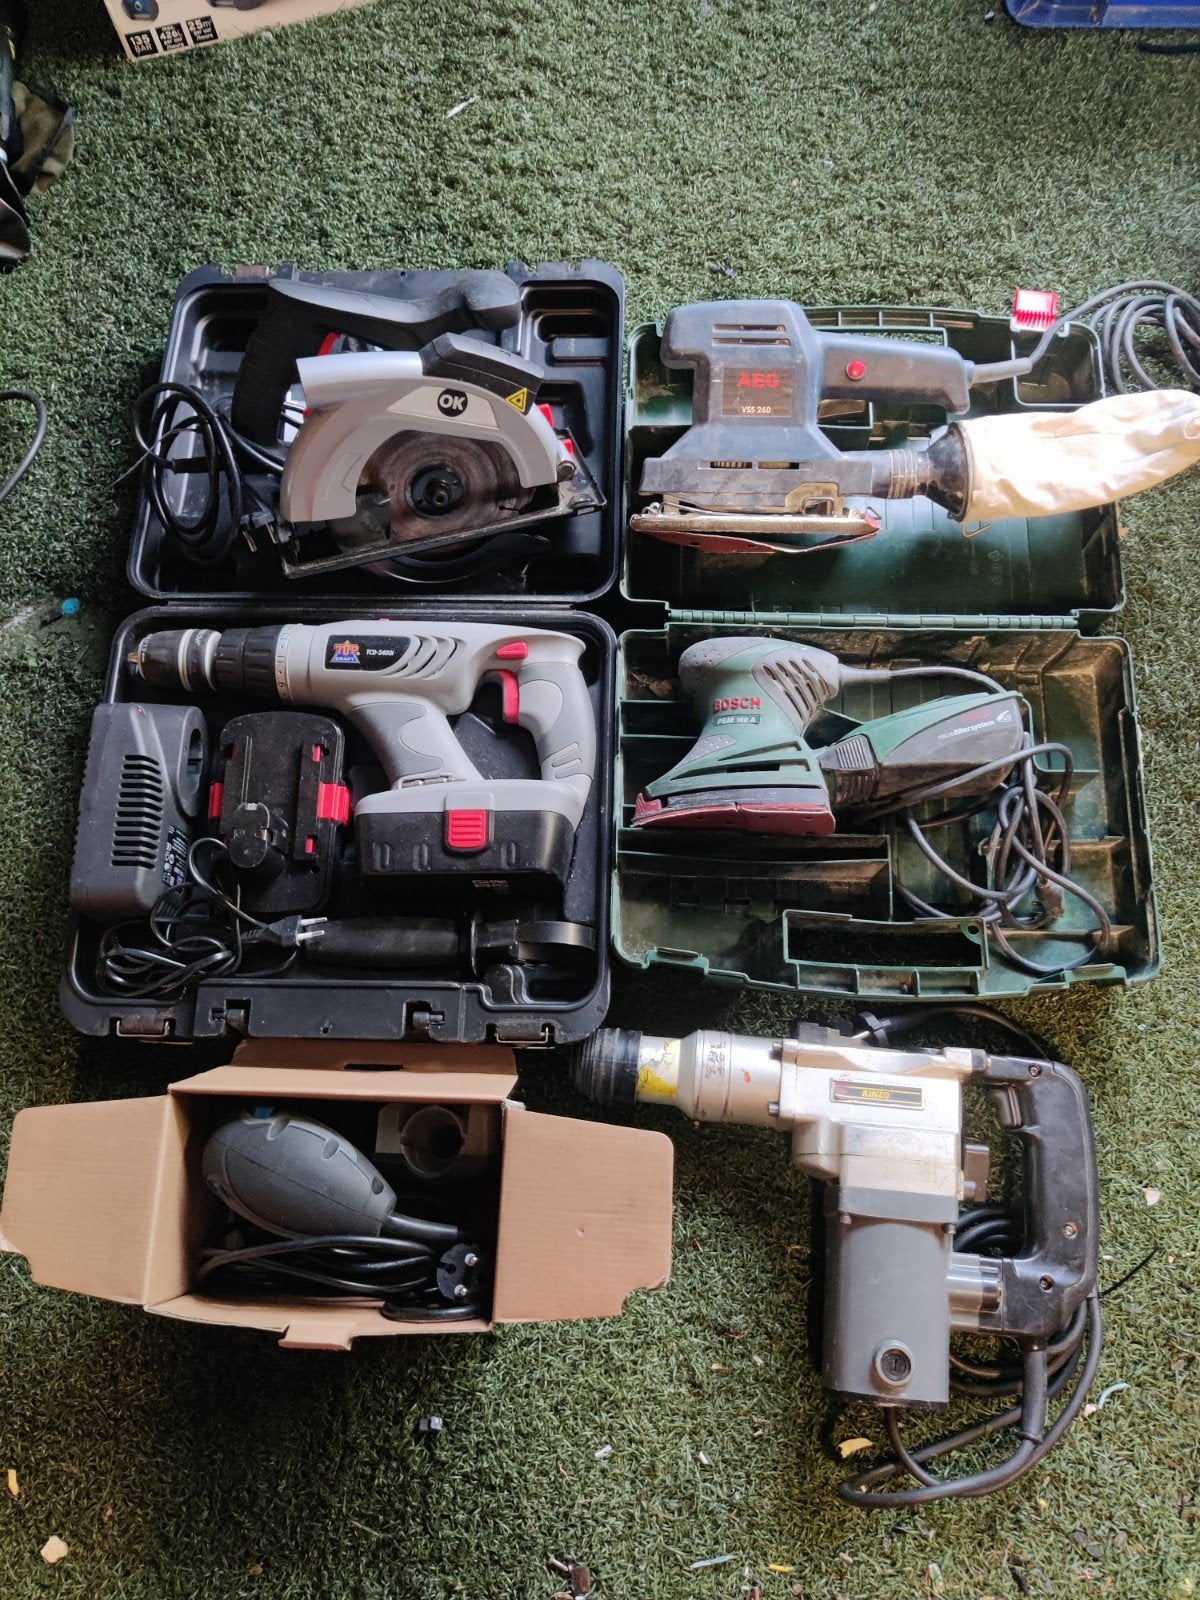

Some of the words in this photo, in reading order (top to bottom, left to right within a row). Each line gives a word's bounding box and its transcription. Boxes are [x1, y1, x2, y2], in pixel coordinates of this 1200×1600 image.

[736, 372, 780, 388] AEG
[439, 394, 466, 410] OK
[713, 696, 760, 712] BOSCH
[717, 717, 734, 726] PSM
[861, 1088, 890, 1099] KINZO
